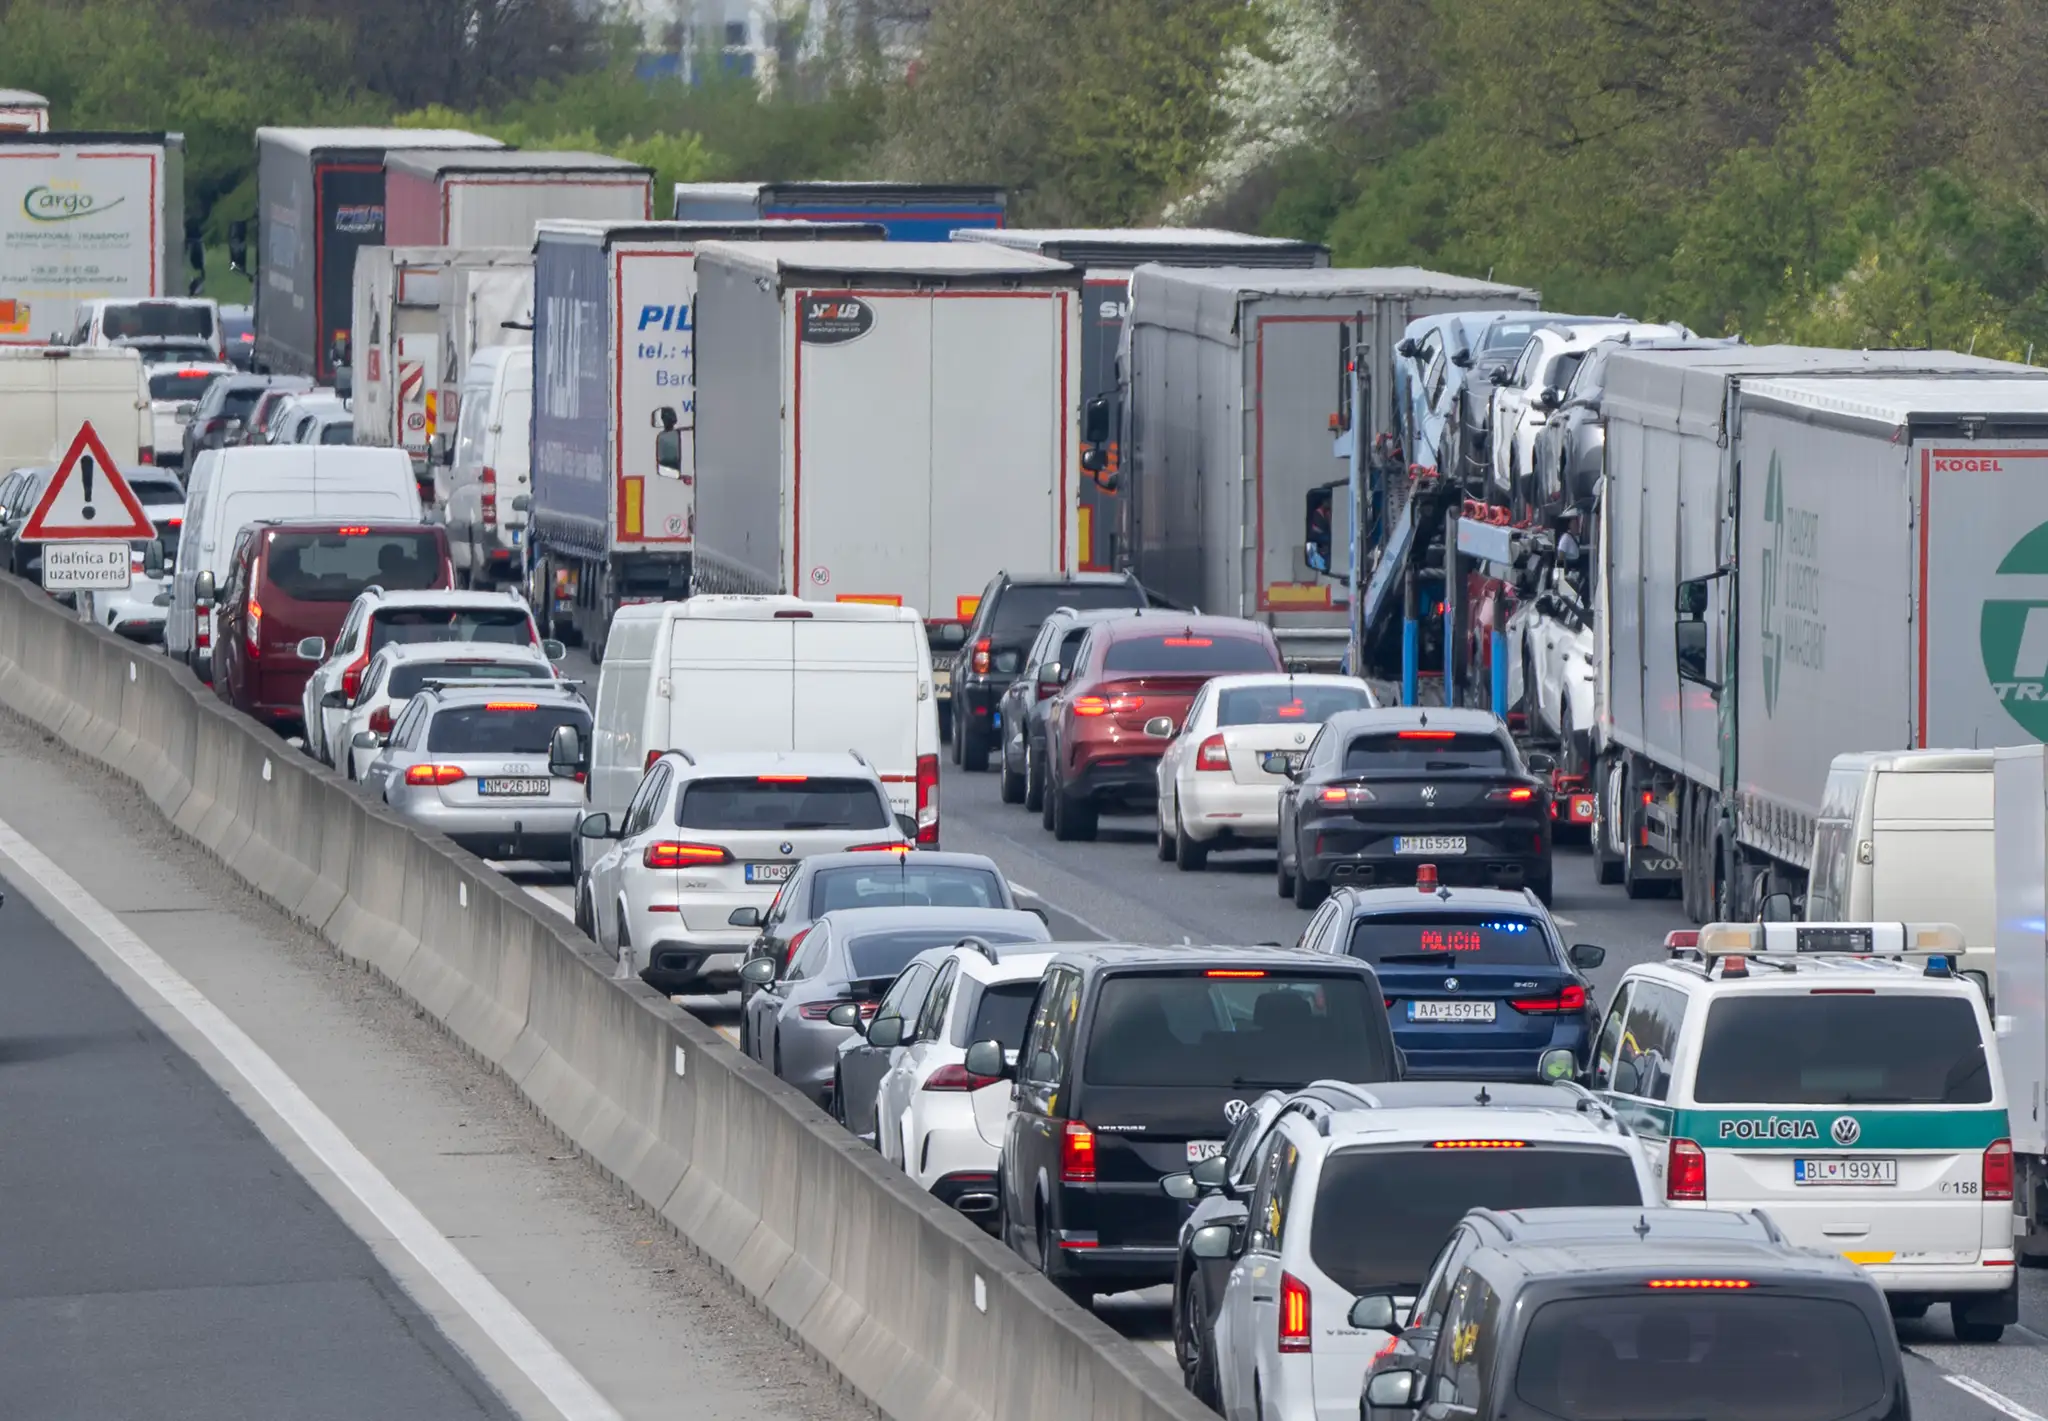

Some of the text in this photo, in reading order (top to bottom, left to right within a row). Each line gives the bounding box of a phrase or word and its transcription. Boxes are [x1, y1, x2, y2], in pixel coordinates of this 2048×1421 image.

[24, 185, 125, 221] Cargo
[50, 551, 124, 565] diaľnica D1
[49, 567, 126, 580] uzatvorená
[815, 569, 826, 581] 90
[1580, 803, 1590, 814] 70
[1719, 1116, 1819, 1139] POLÍCIA
[1953, 1182, 1978, 1194] 158
